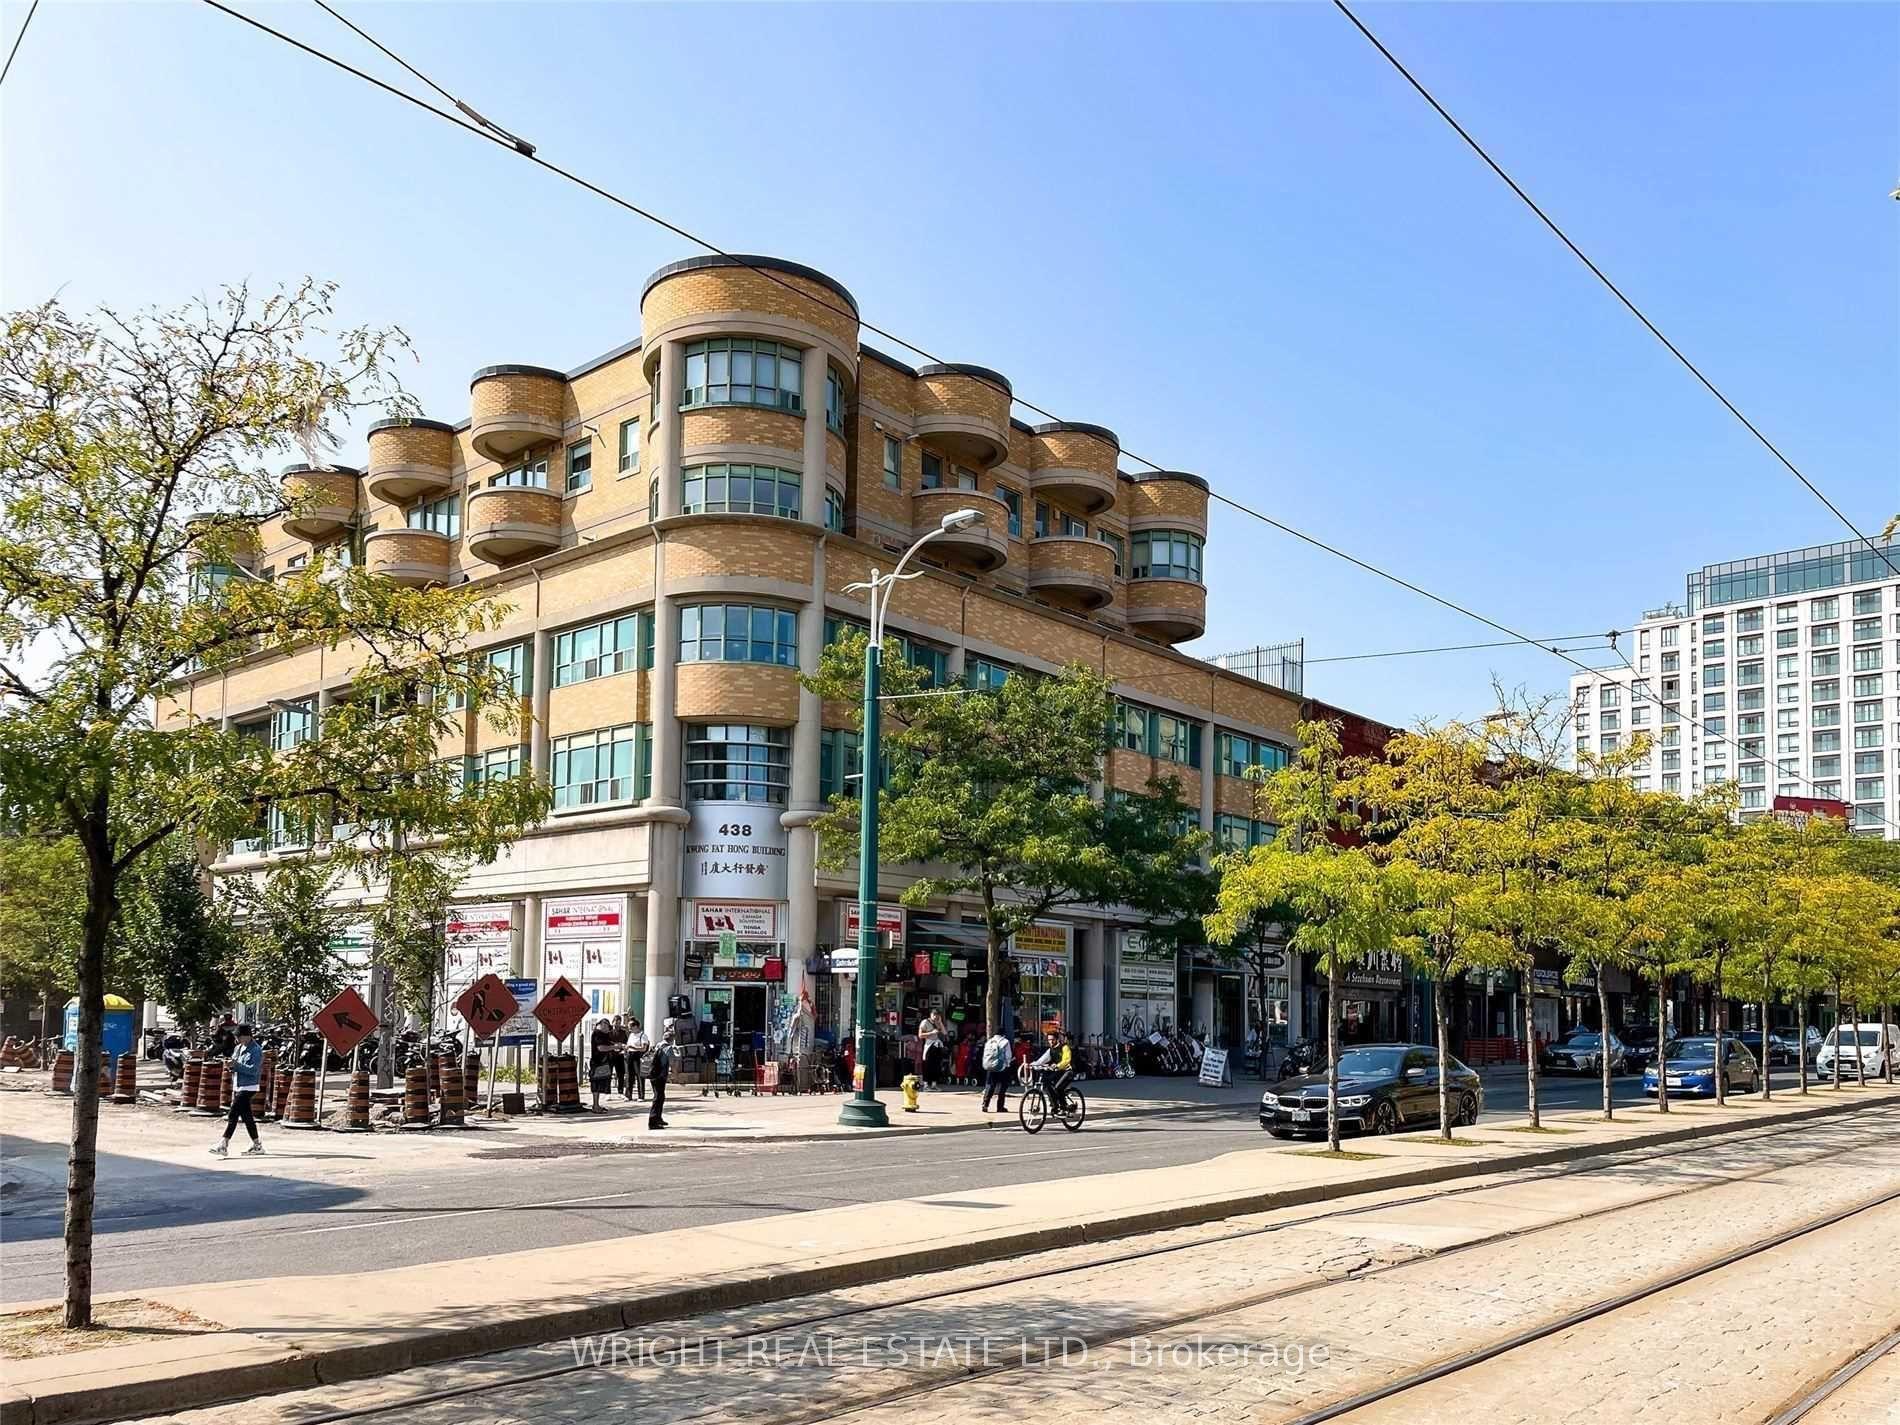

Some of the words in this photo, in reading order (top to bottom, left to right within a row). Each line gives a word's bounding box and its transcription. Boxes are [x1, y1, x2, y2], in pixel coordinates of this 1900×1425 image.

[719, 824, 752, 836] 438
[711, 844, 725, 853] FAT
[727, 844, 749, 854] HONG
[752, 846, 786, 857] BUILDING
